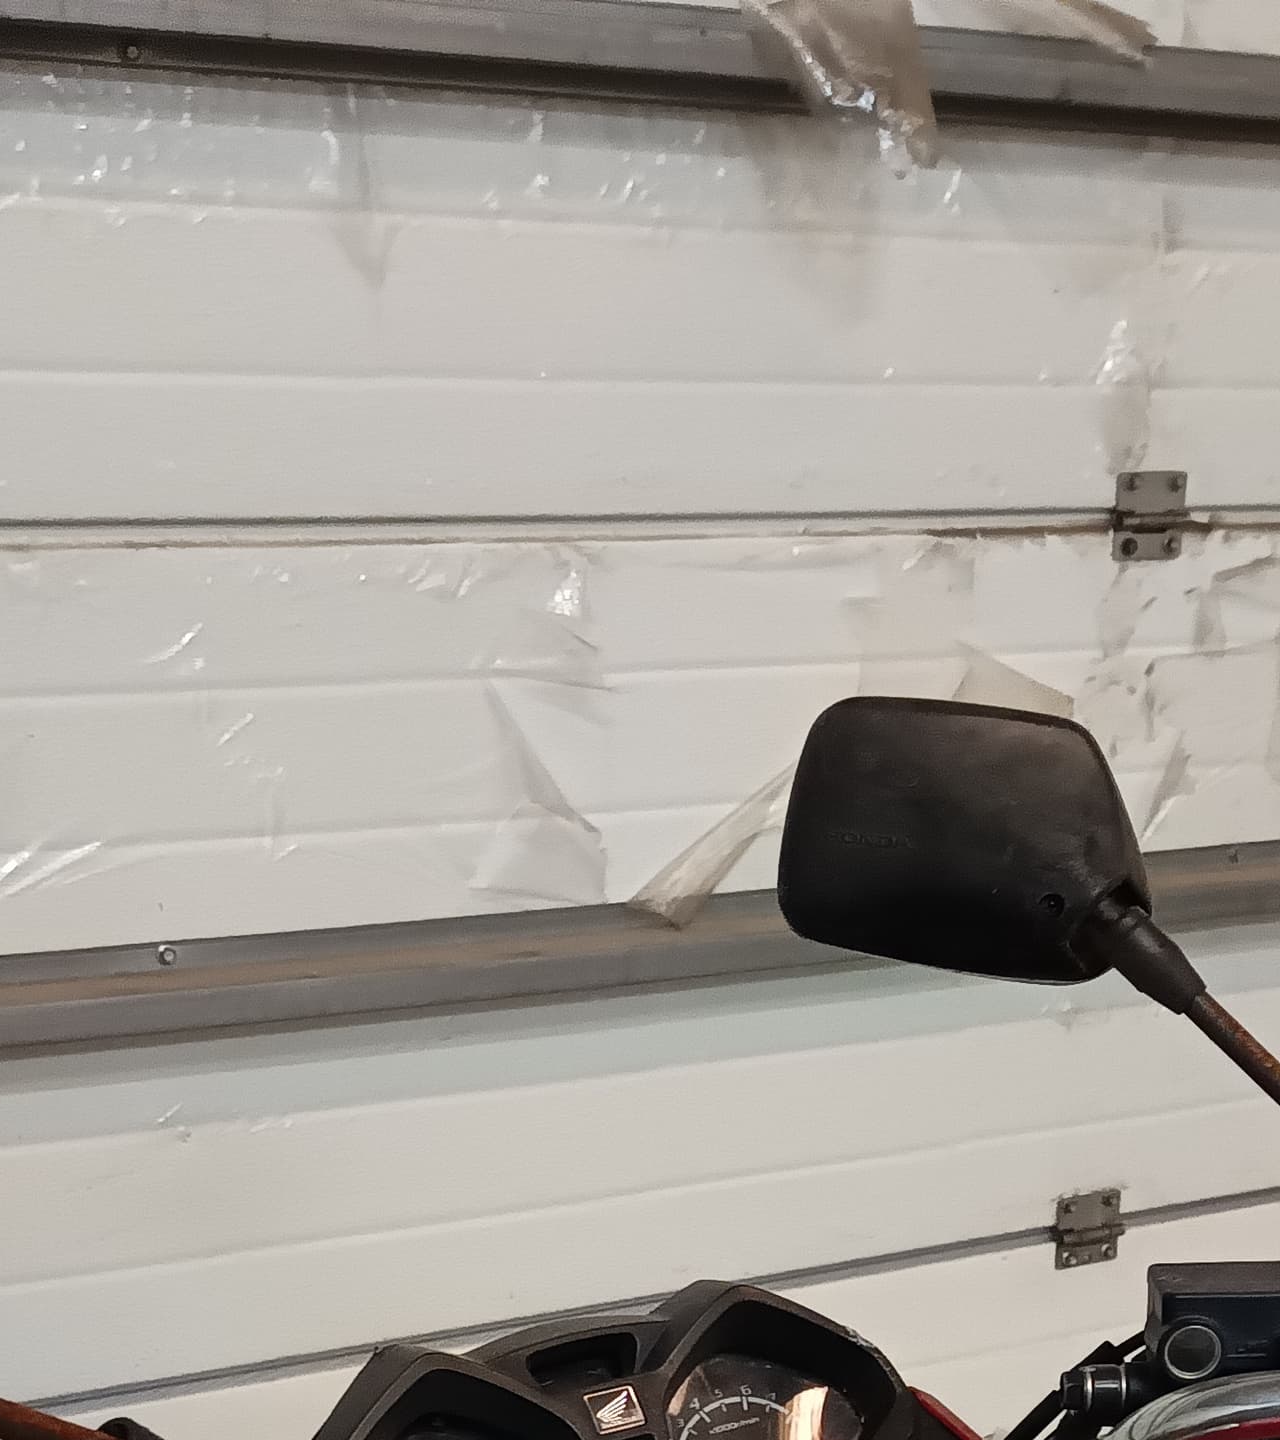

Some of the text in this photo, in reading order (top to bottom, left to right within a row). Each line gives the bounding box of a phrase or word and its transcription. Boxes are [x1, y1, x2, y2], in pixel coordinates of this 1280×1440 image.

[714, 1388, 724, 1398] 5
[740, 1384, 752, 1396] 6
[689, 1397, 700, 1410] 4
[676, 1418, 685, 1428] 3
